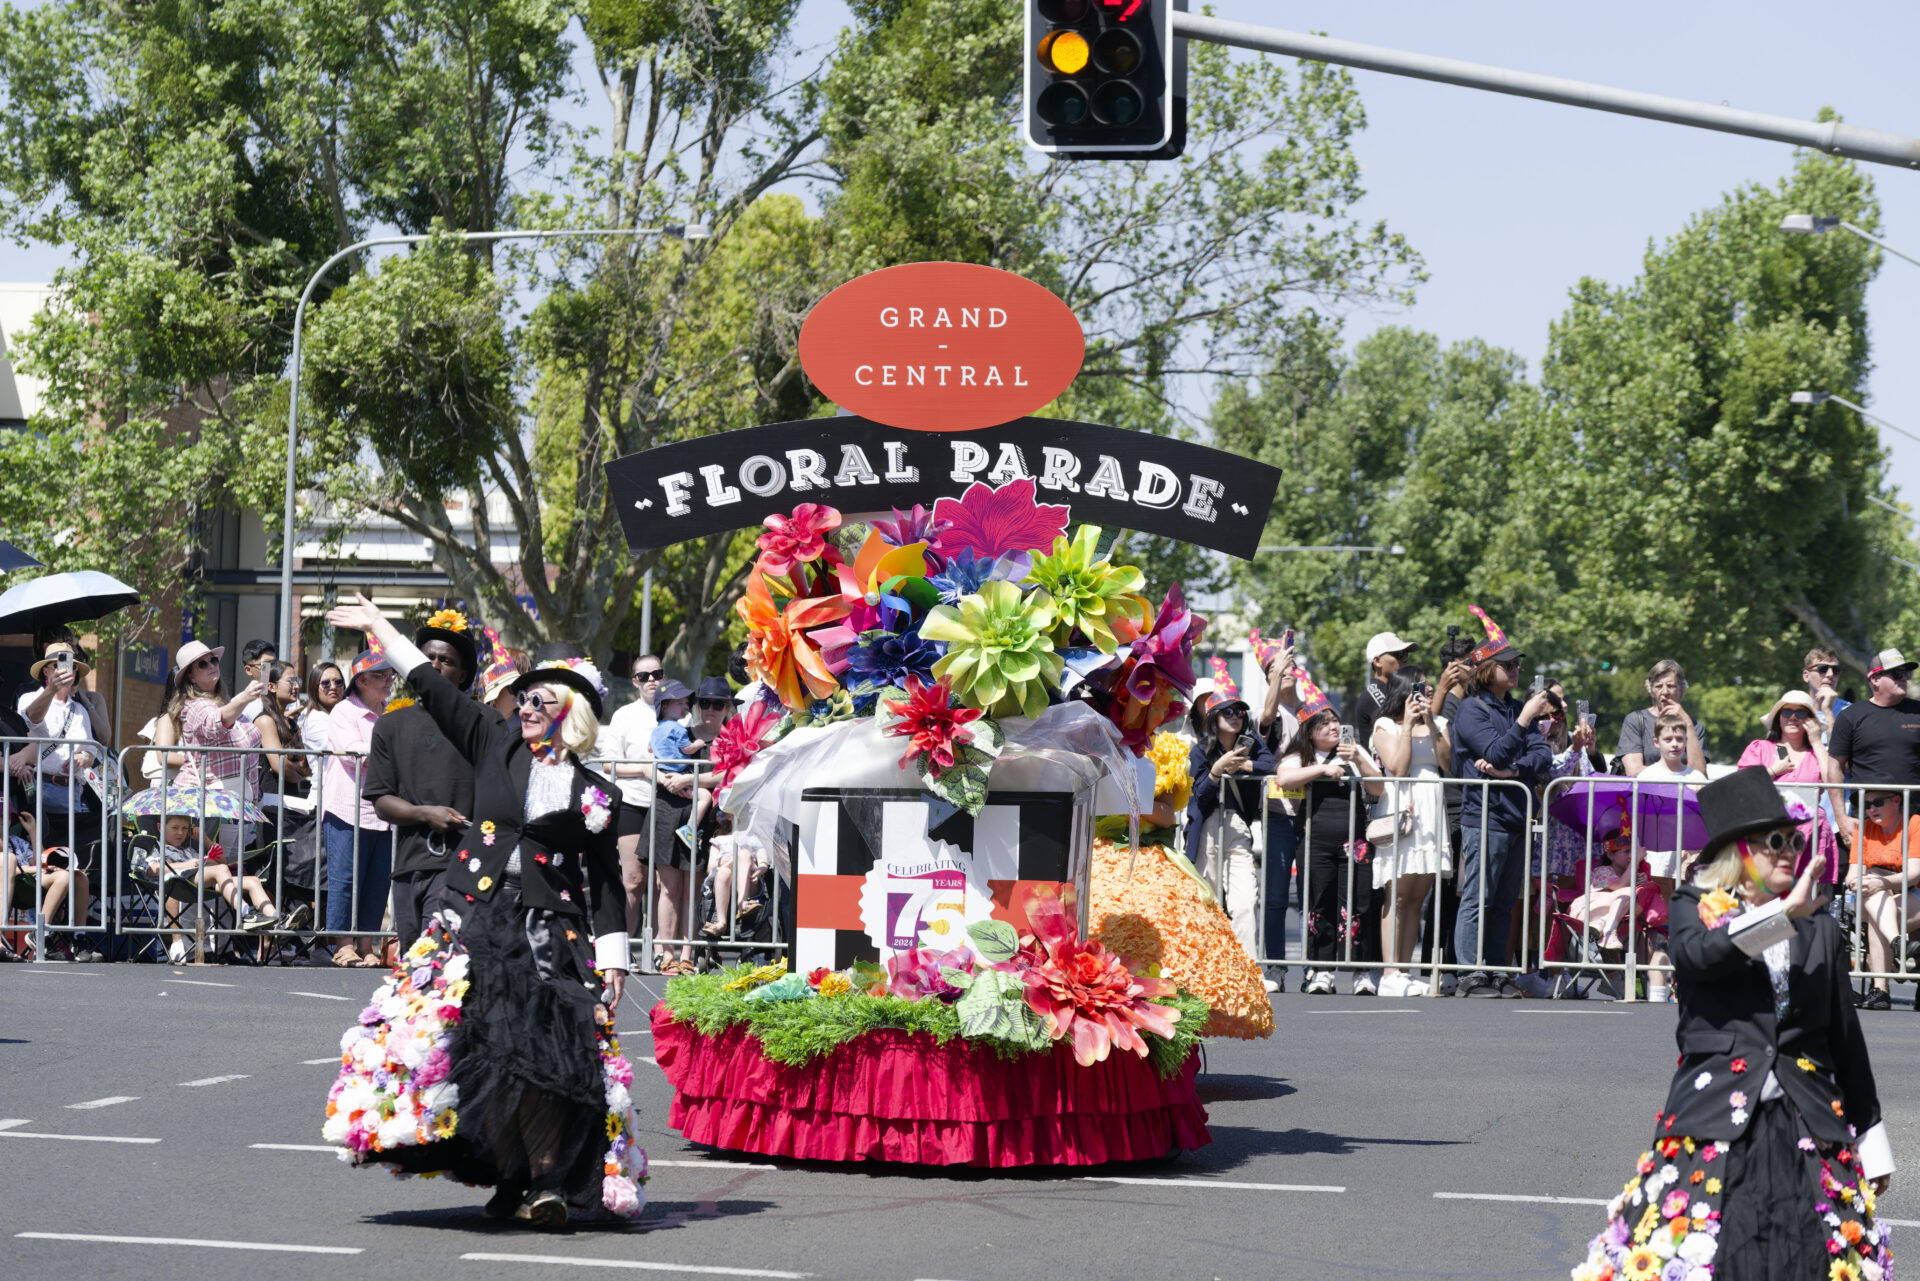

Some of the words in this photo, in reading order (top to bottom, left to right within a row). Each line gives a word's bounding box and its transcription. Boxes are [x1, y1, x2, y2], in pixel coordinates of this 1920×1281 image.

[880, 307, 1008, 328] GRAND
[855, 365, 1028, 386] CENTRAL
[657, 441, 920, 517] FLORAL
[950, 440, 1226, 523] PARADE
[887, 860, 966, 875] CELEBRATING
[935, 879, 962, 887] YEARS
[887, 879, 966, 951] 75
[893, 939, 913, 947] 2024
